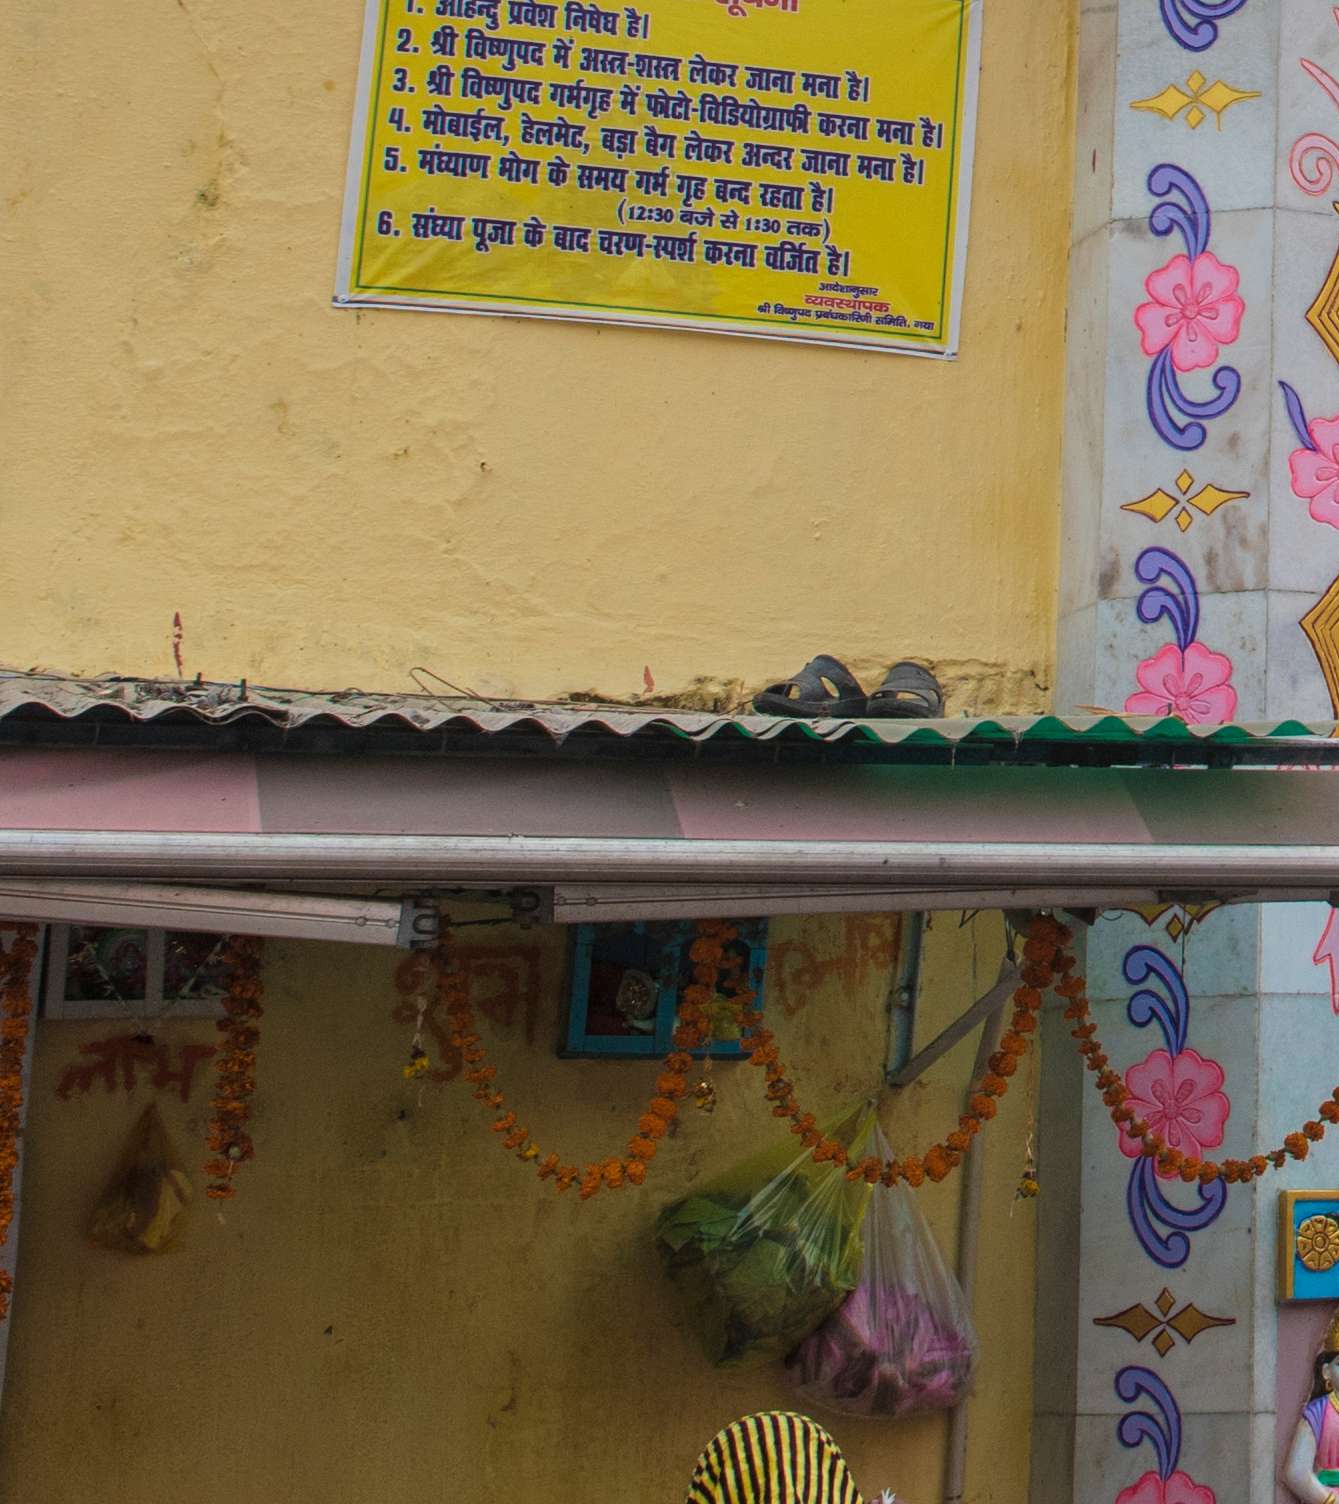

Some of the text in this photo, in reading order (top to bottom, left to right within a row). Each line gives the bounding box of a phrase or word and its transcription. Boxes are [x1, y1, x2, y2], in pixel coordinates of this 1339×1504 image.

[623, 7, 649, 39] है।
[396, 28, 419, 53] 2.
[430, 24, 459, 56] श्री
[464, 27, 546, 71] विष्णुपद
[551, 37, 574, 69] में
[687, 53, 739, 87] लेकर
[744, 66, 795, 93] जाना
[800, 72, 841, 99] मना
[845, 70, 869, 102] है।
[392, 67, 415, 92] 3.
[426, 64, 455, 96] श्री
[460, 66, 542, 110] विष्णुपद
[549, 78, 613, 119] गर्भगृह
[619, 83, 641, 115] में
[816, 112, 870, 140] करना
[875, 118, 915, 145] मना
[919, 116, 942, 148] है।
[388, 107, 410, 132] 4.
[600, 127, 638, 159] बड़ा
[643, 125, 677, 158] बैग
[683, 129, 734, 164] लेकर
[741, 142, 794, 170] अन्दर
[799, 148, 851, 176] जाना
[856, 154, 896, 181] मना
[899, 152, 923, 184] है।
[384, 146, 406, 172] 5.
[498, 150, 541, 184] भोग
[546, 155, 570, 186] के
[576, 164, 629, 192] समय
[634, 165, 670, 196] गर्भ
[675, 174, 707, 207] गृह
[713, 178, 752, 205] बन्द
[758, 183, 805, 210] रहता
[808, 181, 833, 213] है।
[377, 210, 400, 236] 6.
[471, 217, 517, 252] पूजा
[522, 216, 546, 247] के
[552, 225, 592, 252] बाद
[597, 229, 697, 262] चरण-स्पर्श
[703, 239, 758, 267] करना
[764, 240, 821, 274] वर्जित
[824, 244, 849, 276] है।
[617, 198, 830, 244] (12:30 बजे से 1:30 तक)
